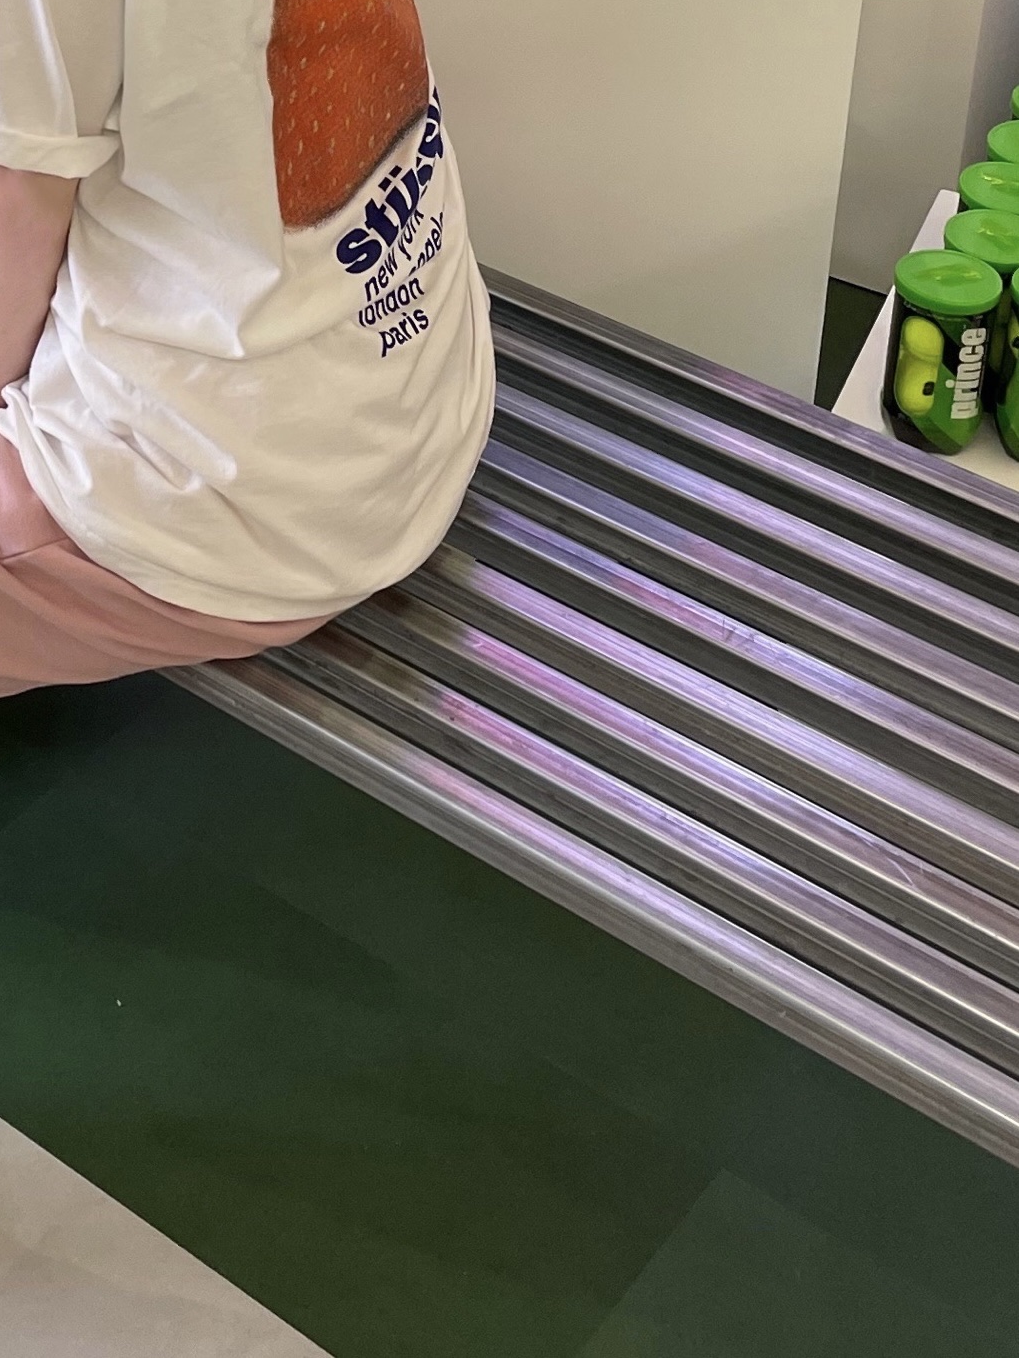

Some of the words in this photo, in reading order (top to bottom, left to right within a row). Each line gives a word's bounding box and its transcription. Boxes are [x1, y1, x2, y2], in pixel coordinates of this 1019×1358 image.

[365, 246, 399, 303] new
[359, 278, 425, 328] london
[379, 308, 430, 358] paris
[945, 327, 987, 420] prince
